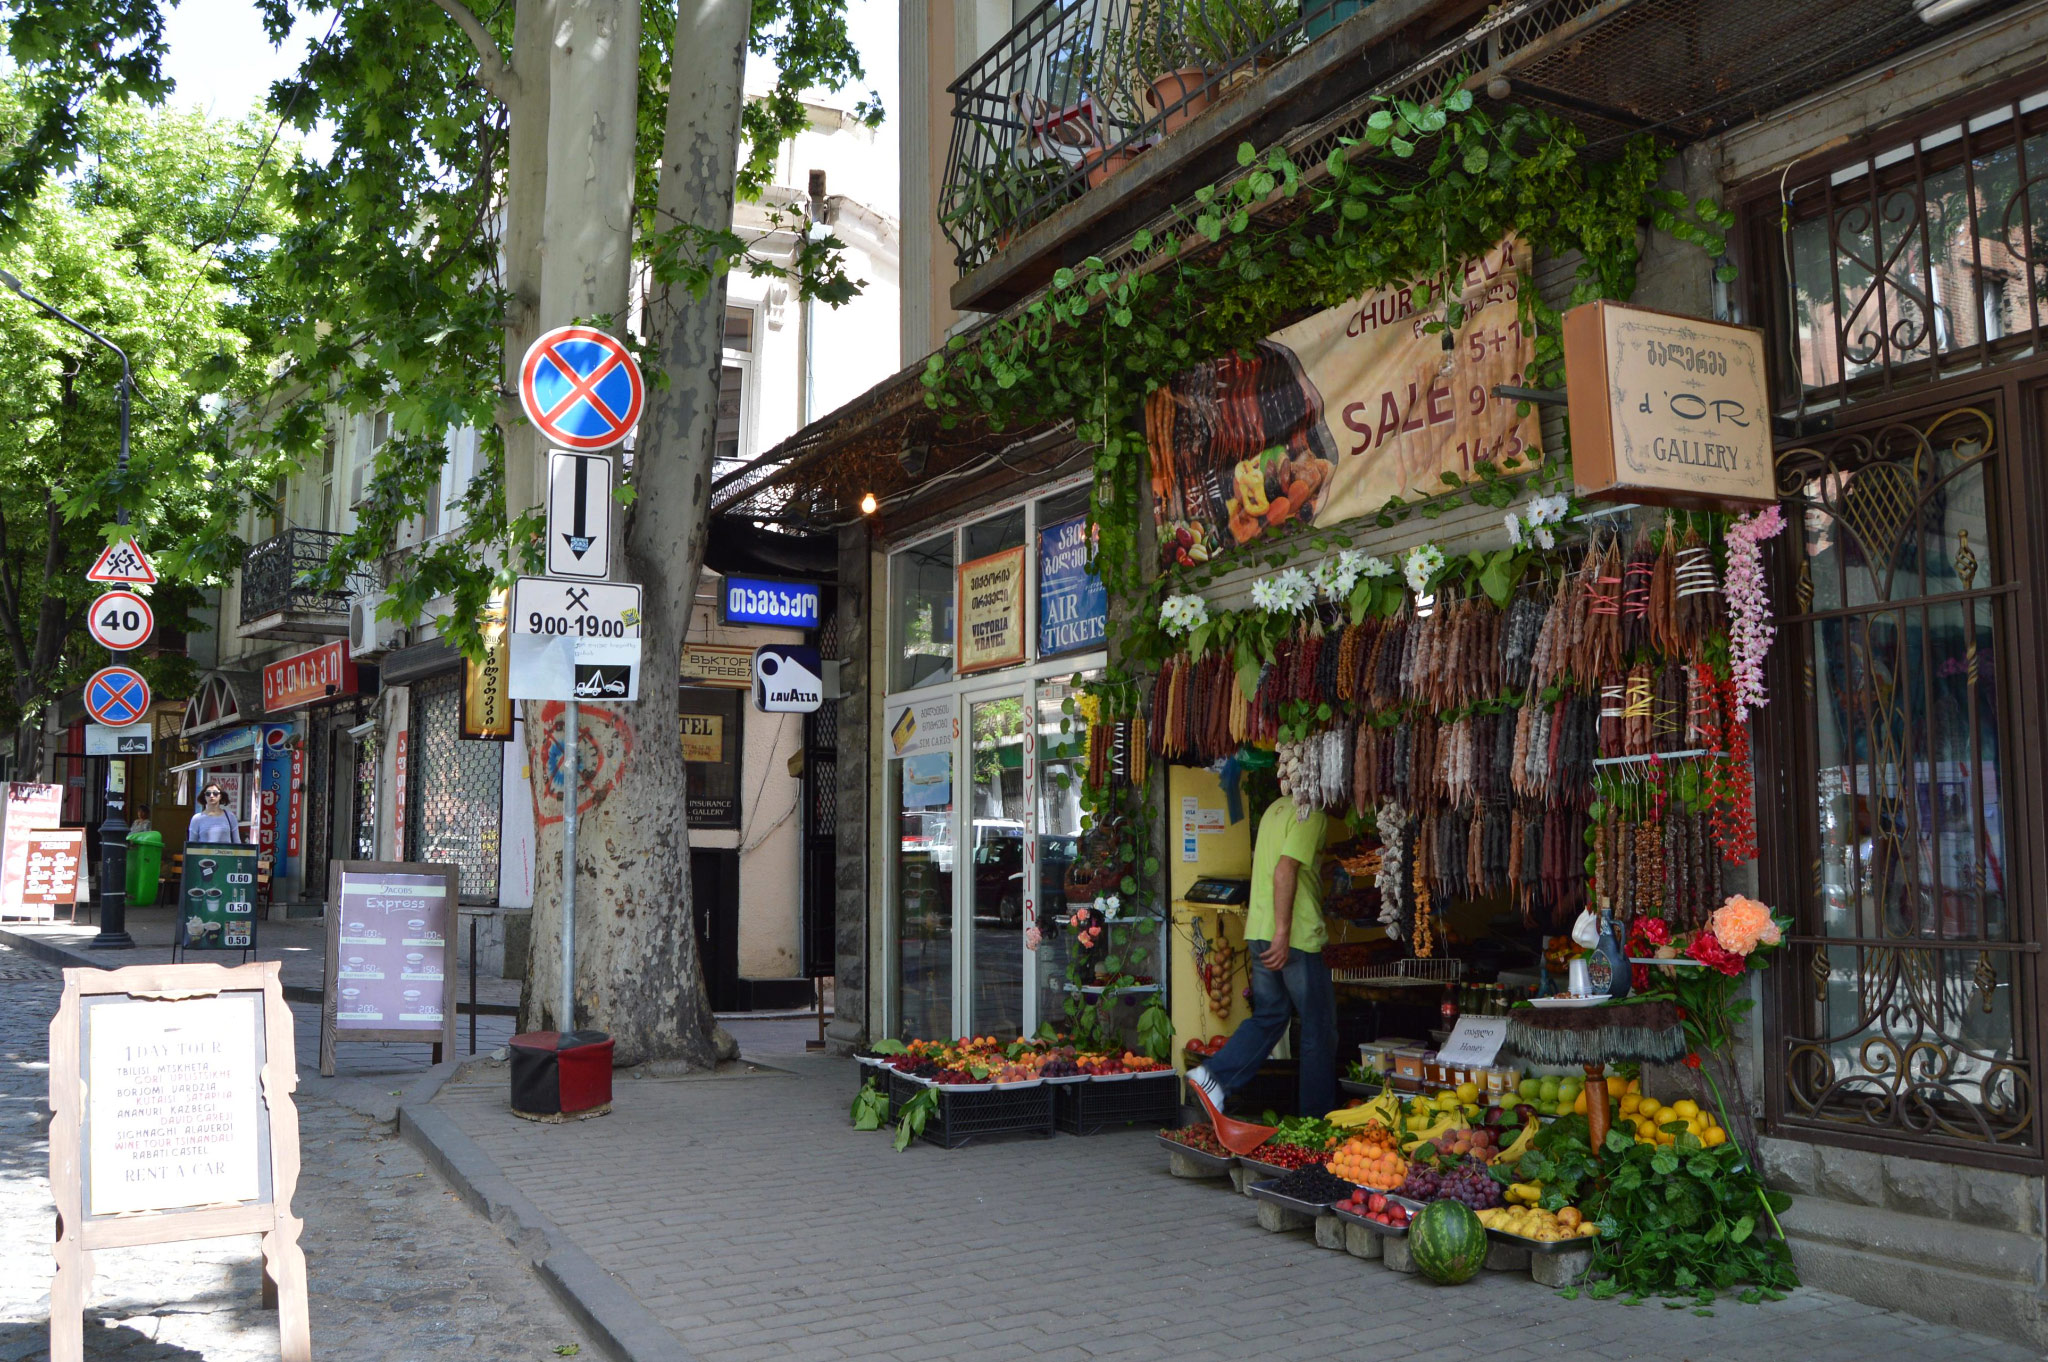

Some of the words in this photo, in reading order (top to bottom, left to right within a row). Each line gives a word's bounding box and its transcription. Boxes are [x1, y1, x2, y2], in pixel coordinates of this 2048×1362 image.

[1346, 240, 1516, 339] CHURHELA
[1469, 320, 1521, 363] 5+1
[1647, 340, 1728, 377] გალერეა
[1341, 381, 1455, 457] SALE
[1652, 437, 1738, 473] GALLERY
[970, 567, 1011, 591] ვიქტორია
[729, 587, 818, 619] თამბაქო
[1046, 593, 1079, 626] AIR
[101, 610, 140, 631] 40
[529, 612, 624, 638] 9.00-19.00
[972, 616, 1009, 638] VICTORIA
[1045, 614, 1106, 649] TICKETS
[975, 632, 1006, 651] TRAVEL
[267, 651, 337, 699] აფთიაქი
[484, 646, 499, 726] ბილეთები
[770, 688, 819, 703] LAVAZZA
[679, 717, 713, 736] TEL
[919, 738, 930, 748] SIM
[931, 735, 951, 746] CARDS
[290, 750, 301, 850] აფთიაქი
[396, 739, 407, 858] აფთიაქი
[689, 800, 732, 808] INSURANCE
[692, 808, 725, 816] GALLERY
[1025, 705, 1036, 949] SOUVENIR
[230, 874, 249, 883] 0.60
[382, 886, 413, 894] JACOBS
[229, 903, 248, 912] 0.50
[366, 898, 425, 914] Express
[228, 936, 247, 945] 0.50
[126, 1046, 131, 1061] 1
[137, 1044, 168, 1058] DAY
[177, 1041, 222, 1055] TOUR
[1459, 1042, 1485, 1053] Honey
[117, 1066, 150, 1076] TBILISI
[157, 1062, 209, 1073] MTSKHETA
[135, 1075, 162, 1084] GORI
[170, 1069, 231, 1081] UPLISTSIKHE
[117, 1086, 164, 1097] BORJOMI
[136, 1095, 176, 1105] KUTAISI
[117, 1107, 162, 1118] ANANURI
[170, 1103, 216, 1114] KAZBEGI
[196, 1112, 233, 1123] GAREJI
[115, 1140, 139, 1150] WINE
[144, 1138, 172, 1148] TOUR
[175, 1133, 234, 1146] TSINANDALI
[117, 1127, 176, 1140] SIGHNAGHI
[133, 1149, 168, 1160] RABATI
[171, 1146, 209, 1156] CASTEL
[125, 1166, 169, 1182] RENT
[177, 1164, 185, 1177] A
[192, 1161, 225, 1175] CAR
